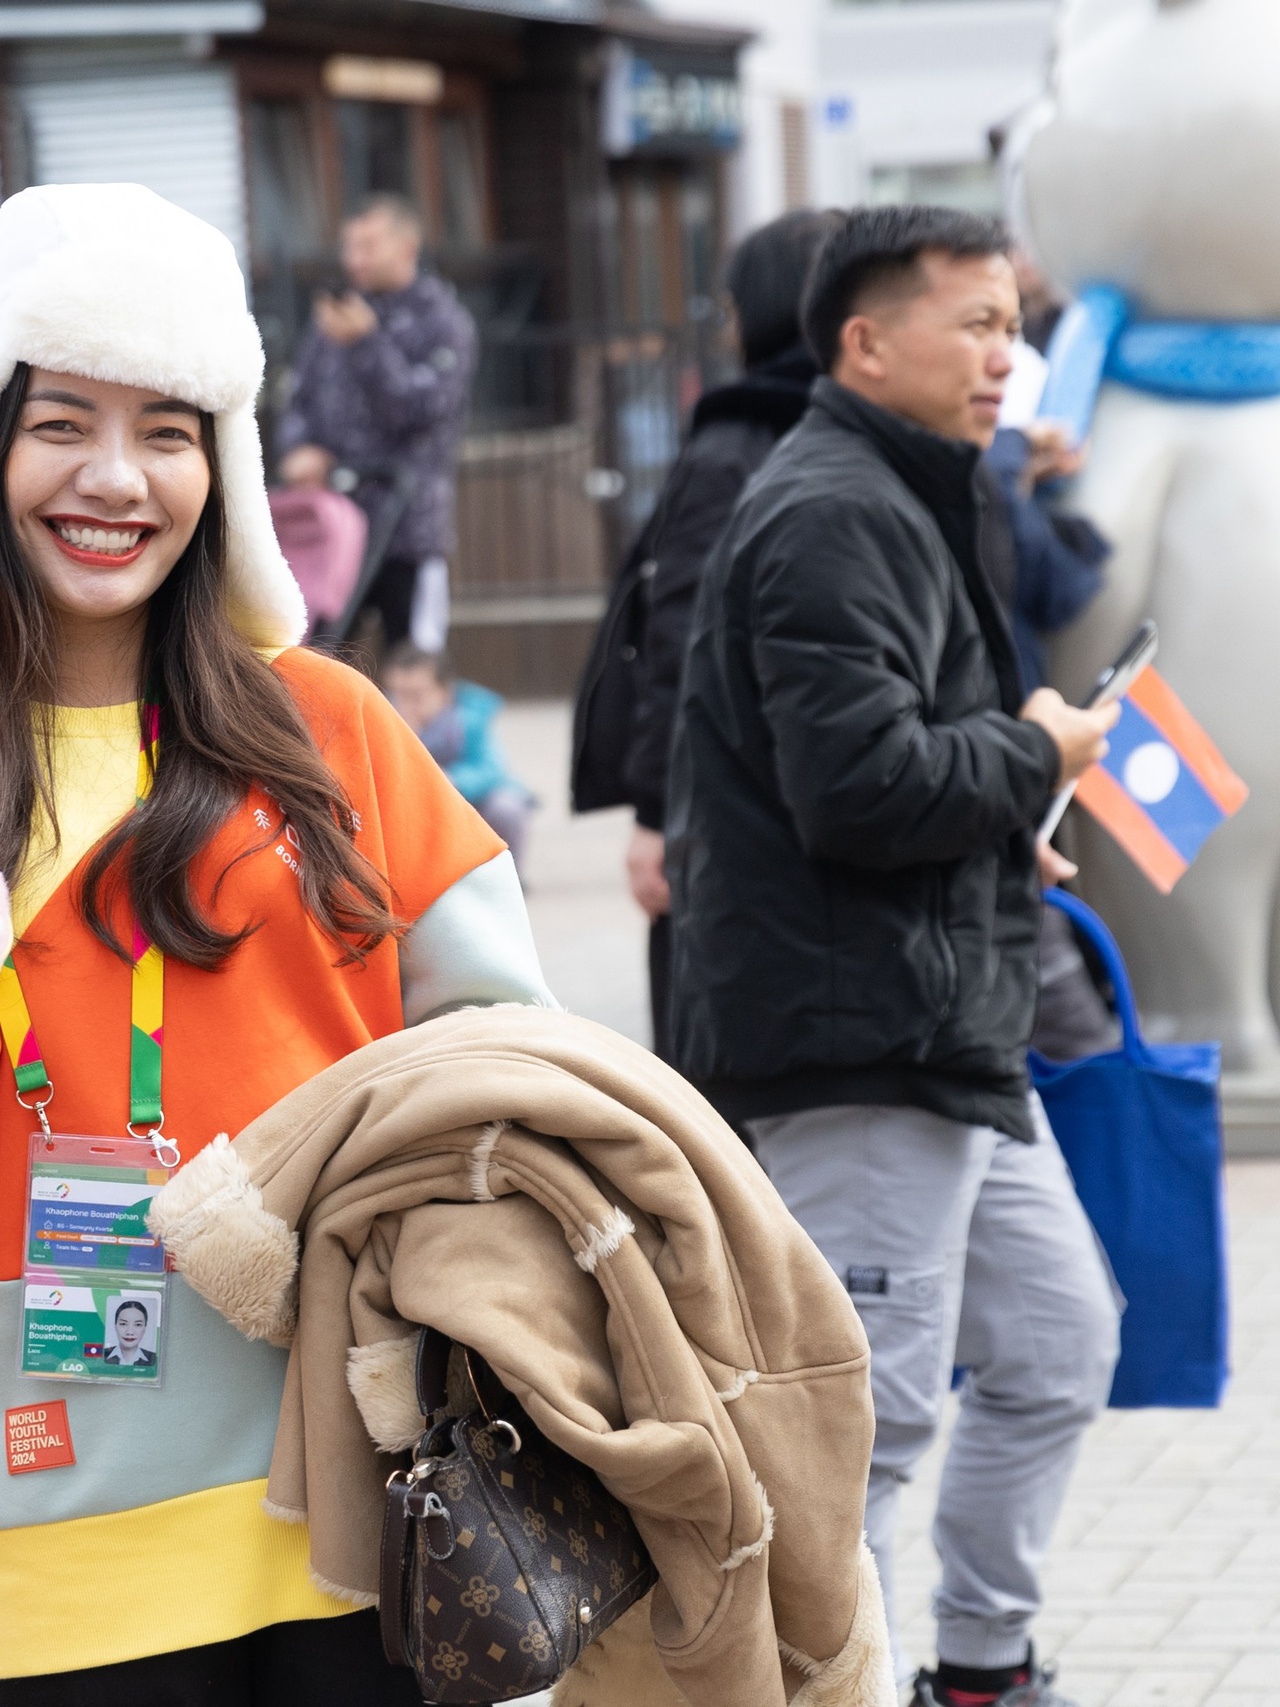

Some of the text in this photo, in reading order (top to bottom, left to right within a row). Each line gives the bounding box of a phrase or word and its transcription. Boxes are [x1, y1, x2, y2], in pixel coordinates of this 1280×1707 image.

[45, 1207, 139, 1221] Khaophone Bouathiphan
[29, 1322, 73, 1332] Khaophone
[28, 1331, 77, 1341] Bouathiphan
[62, 1363, 83, 1372] LAO
[8, 1410, 47, 1427] WORLD
[9, 1423, 46, 1440] YOUTH
[10, 1434, 64, 1454] FESTIVAL
[11, 1451, 36, 1467] 2024
